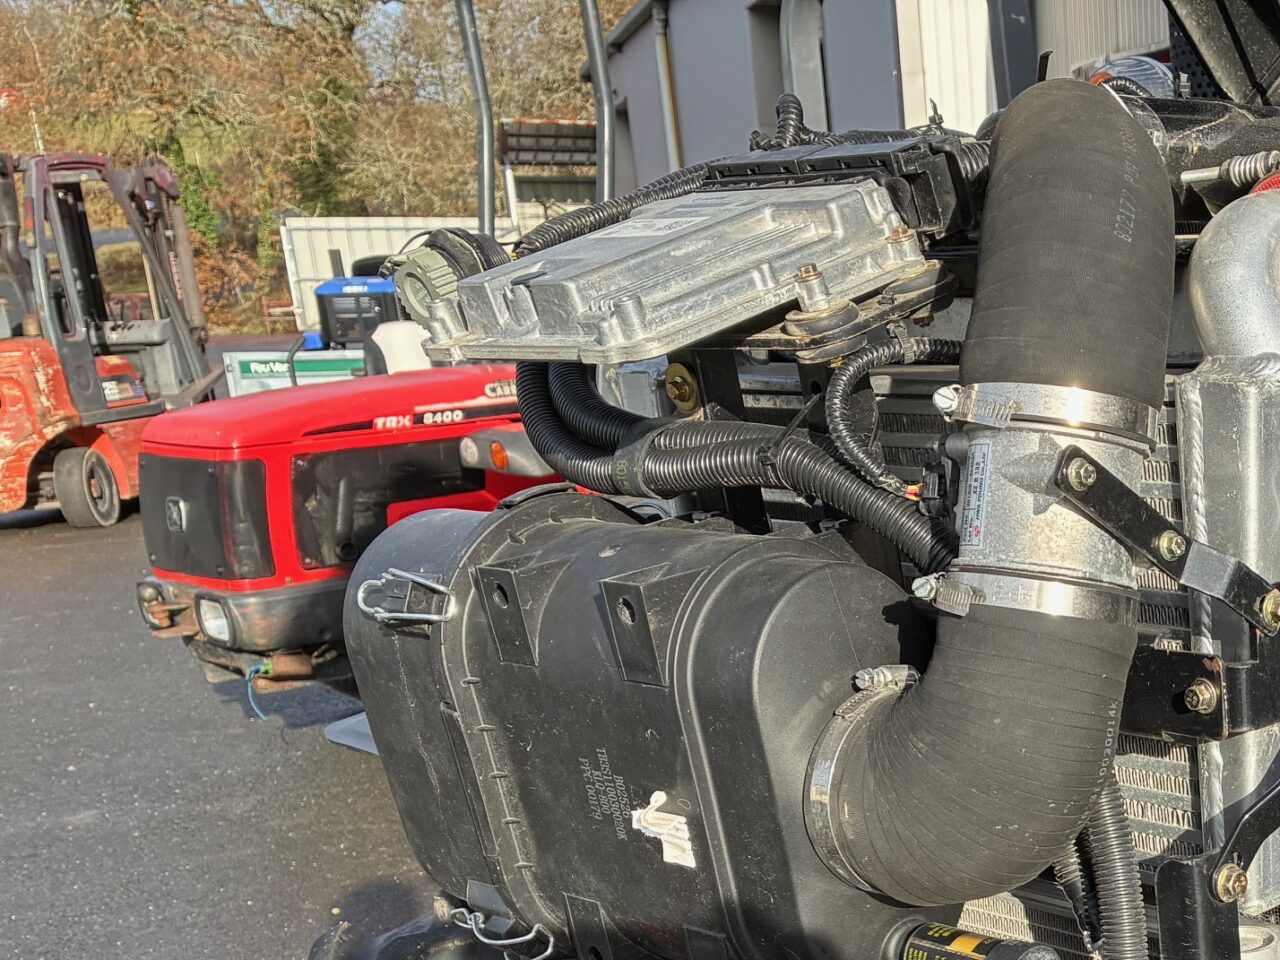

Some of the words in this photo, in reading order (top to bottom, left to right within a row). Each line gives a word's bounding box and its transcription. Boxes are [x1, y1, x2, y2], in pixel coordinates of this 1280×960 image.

[374, 415, 412, 430] TRX
[423, 410, 463, 425] 8400
[578, 757, 593, 782] PPC
[585, 784, 603, 820] 00179
[613, 774, 632, 818] B02526
